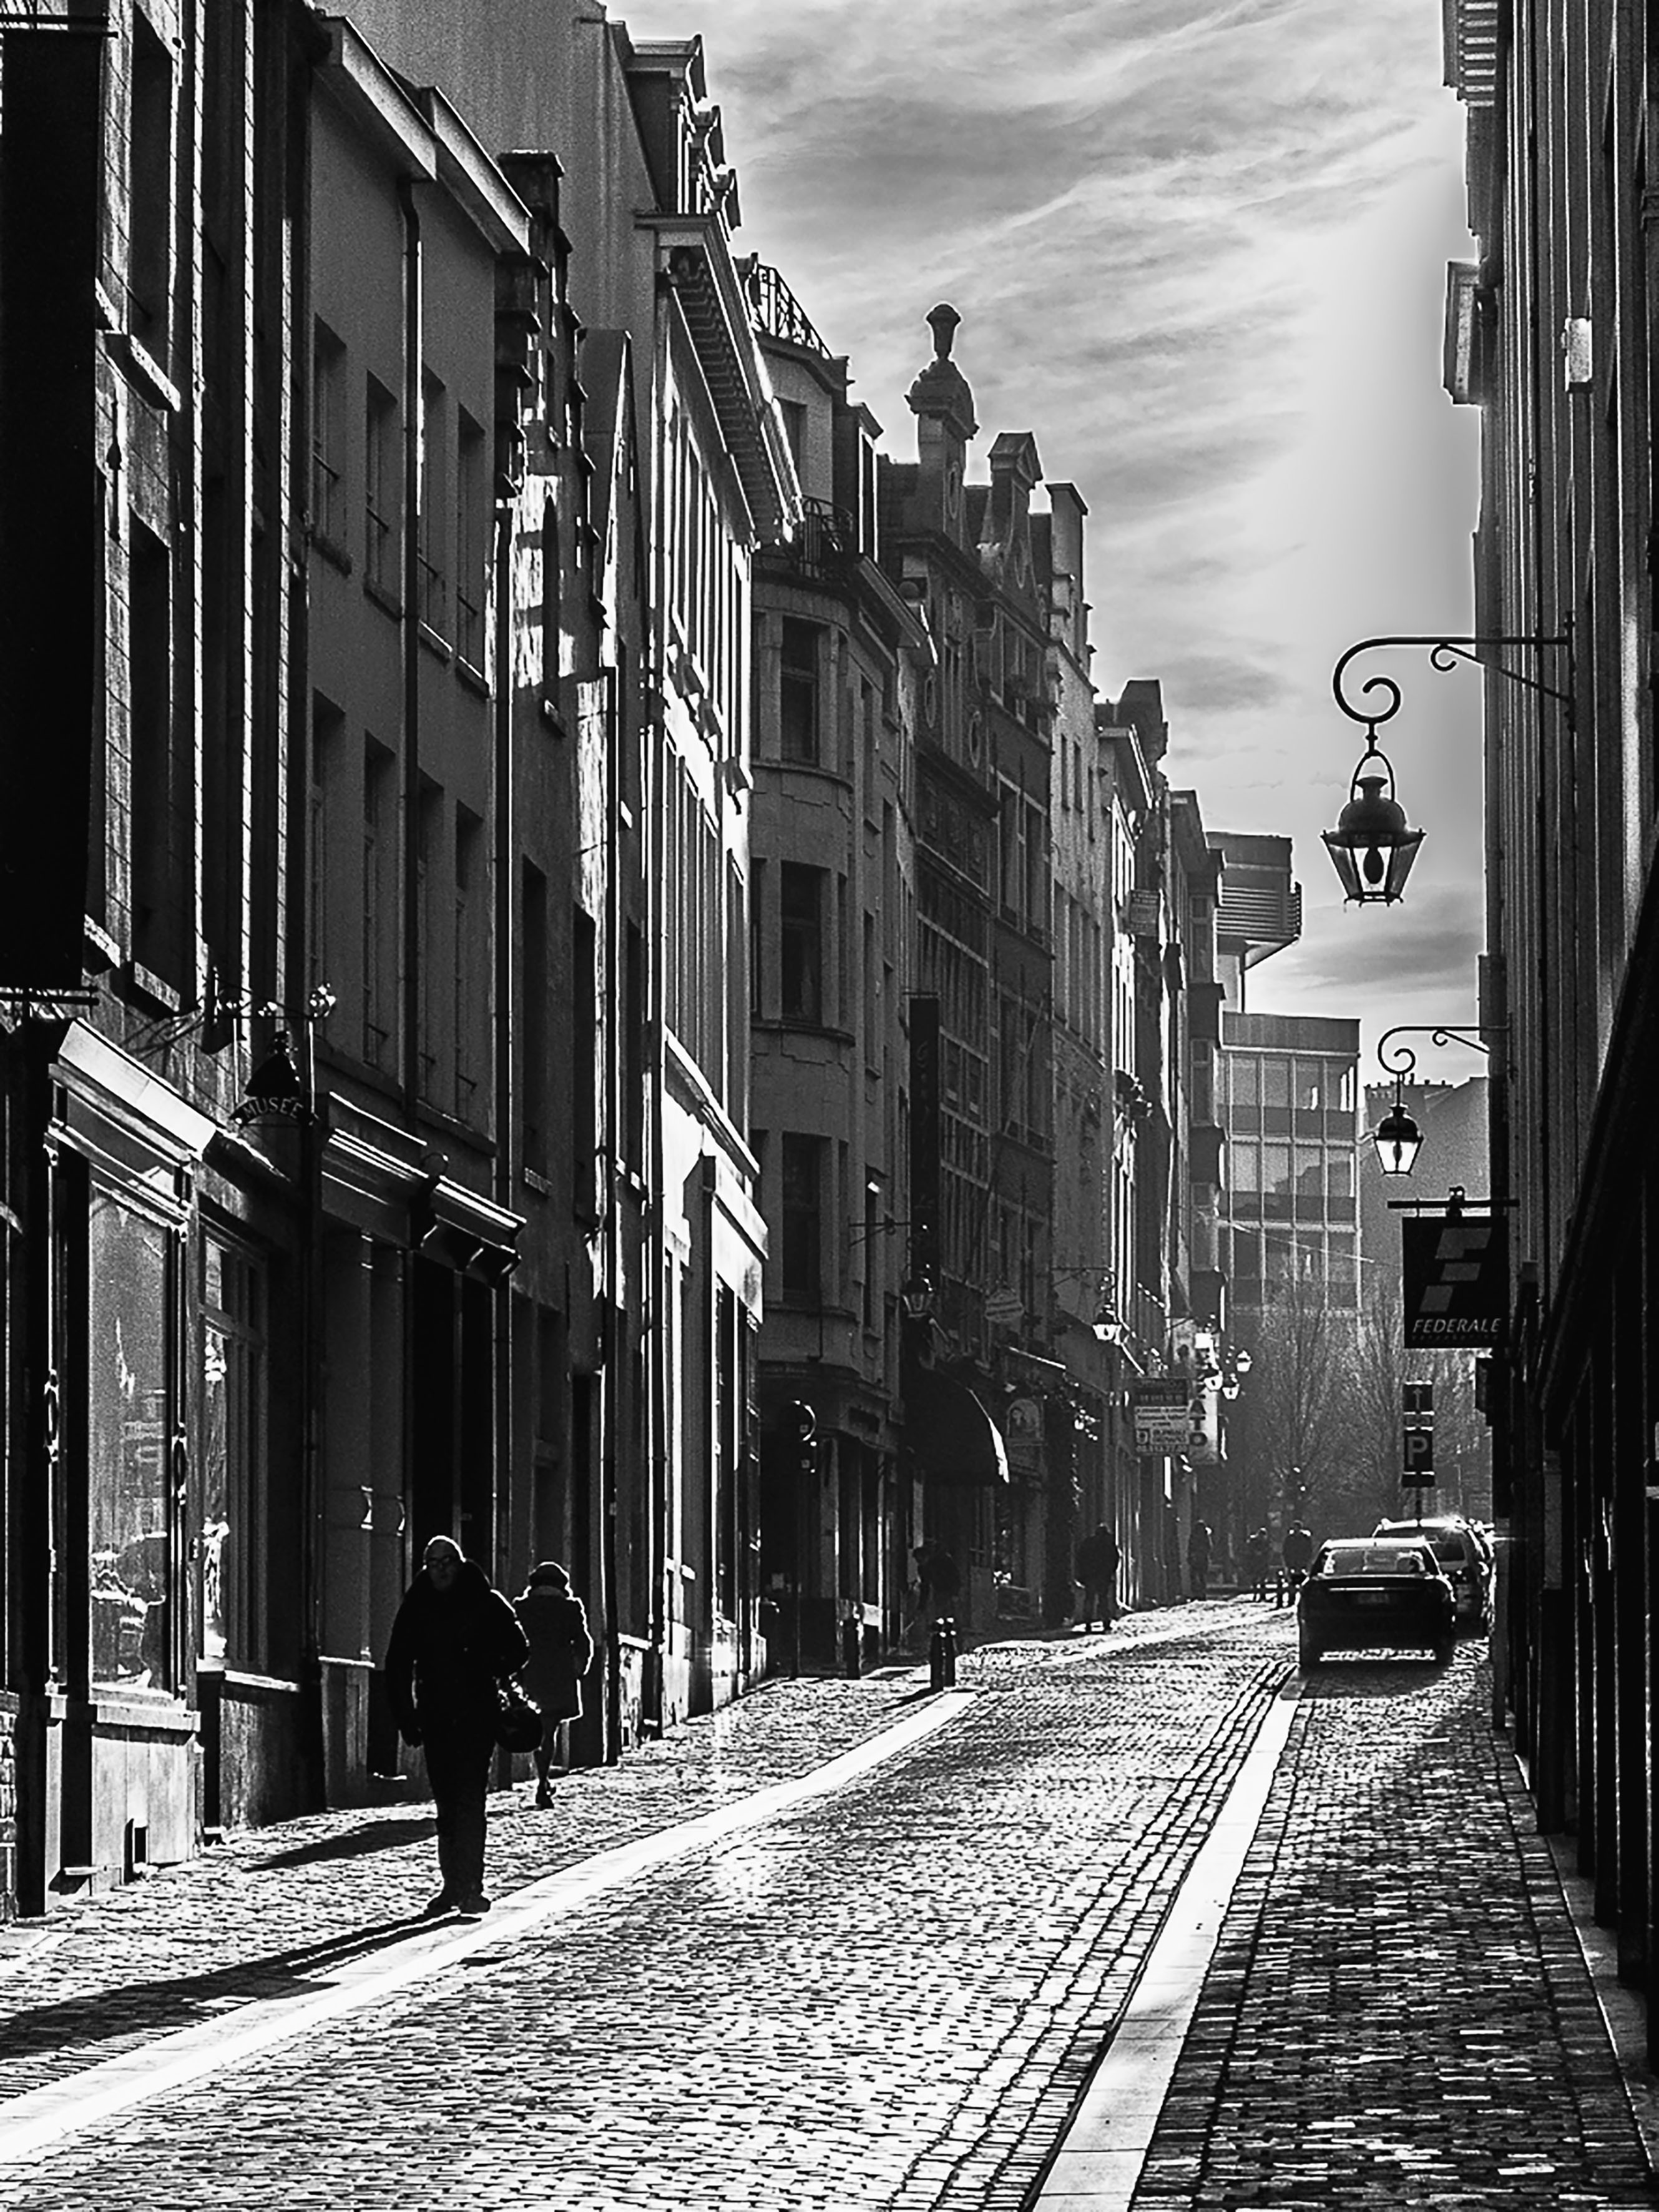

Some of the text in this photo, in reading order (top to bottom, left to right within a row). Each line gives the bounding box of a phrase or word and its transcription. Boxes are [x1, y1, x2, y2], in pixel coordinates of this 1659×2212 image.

[242, 1096, 304, 1119] MUSEE
[1412, 1317, 1502, 1333] FEDERALE
[1407, 1436, 1428, 1465] P
